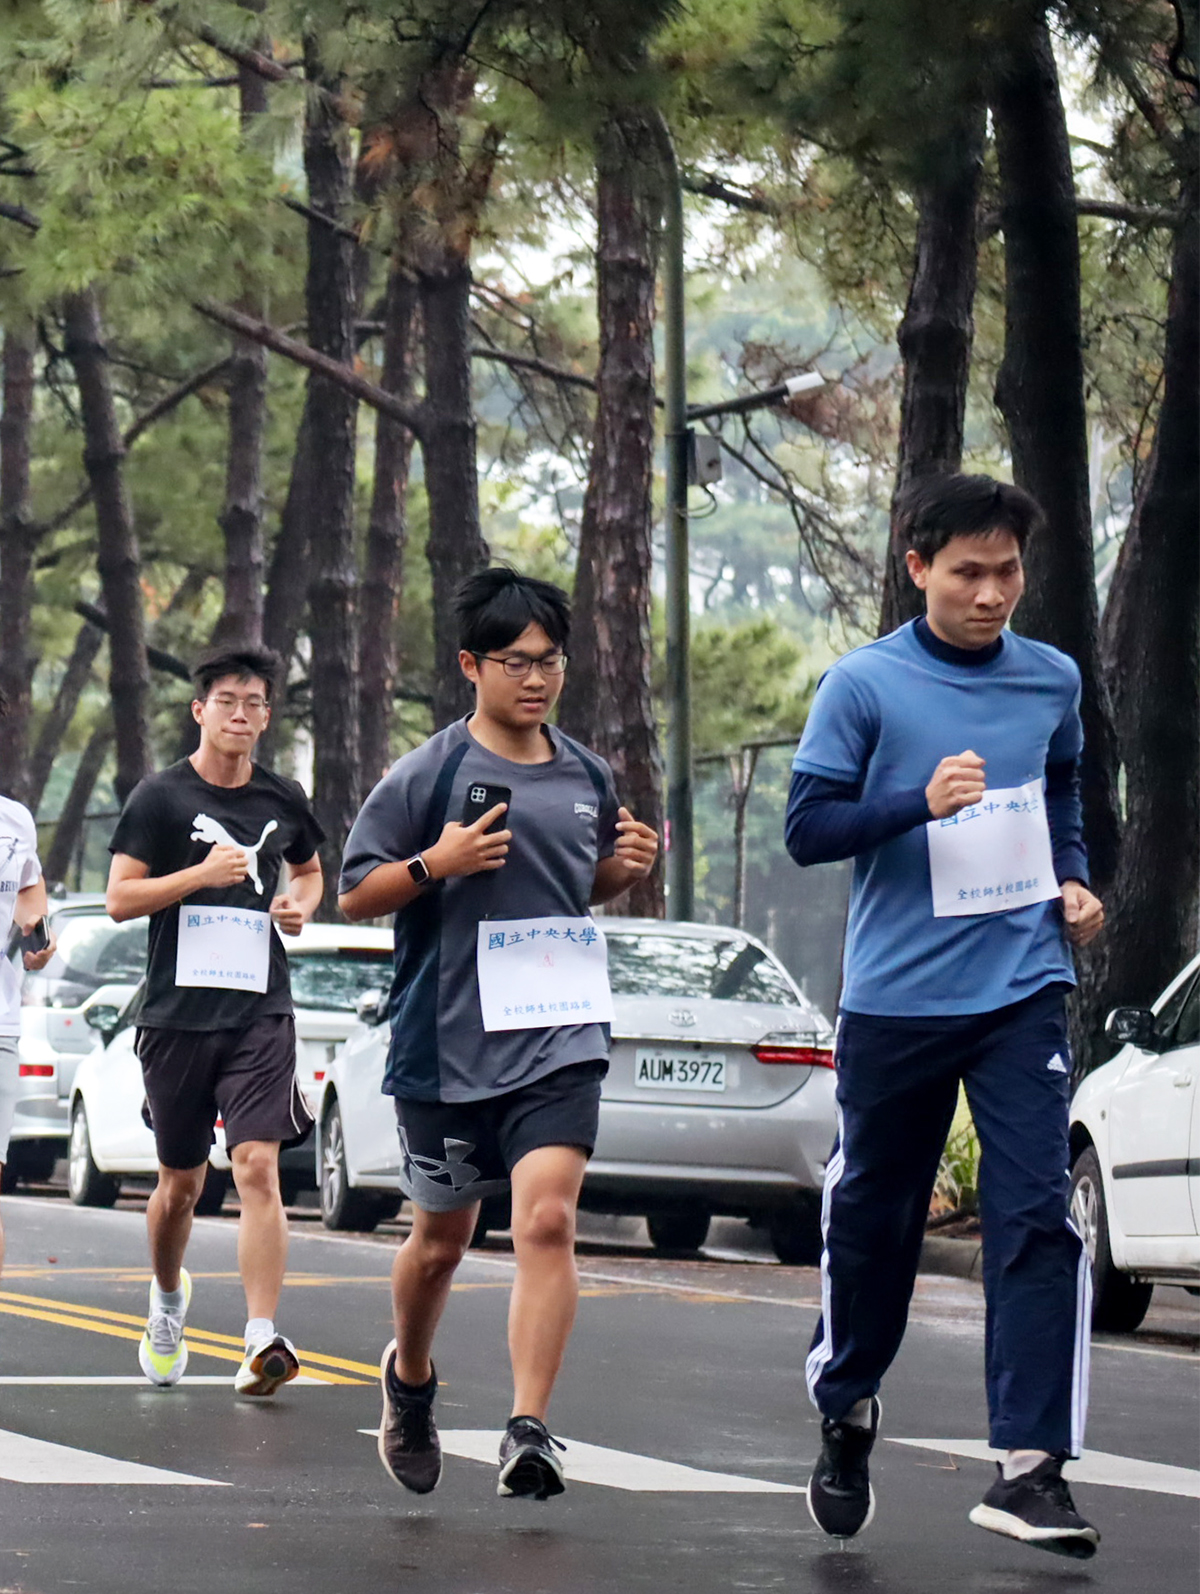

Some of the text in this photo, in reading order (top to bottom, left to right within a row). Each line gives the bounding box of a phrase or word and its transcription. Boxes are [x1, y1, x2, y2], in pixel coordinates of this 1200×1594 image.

[187, 914, 265, 934] 國立中央大學
[487, 926, 598, 951] 國立中央大學
[502, 1000, 593, 1017] 全校師生校園路跑
